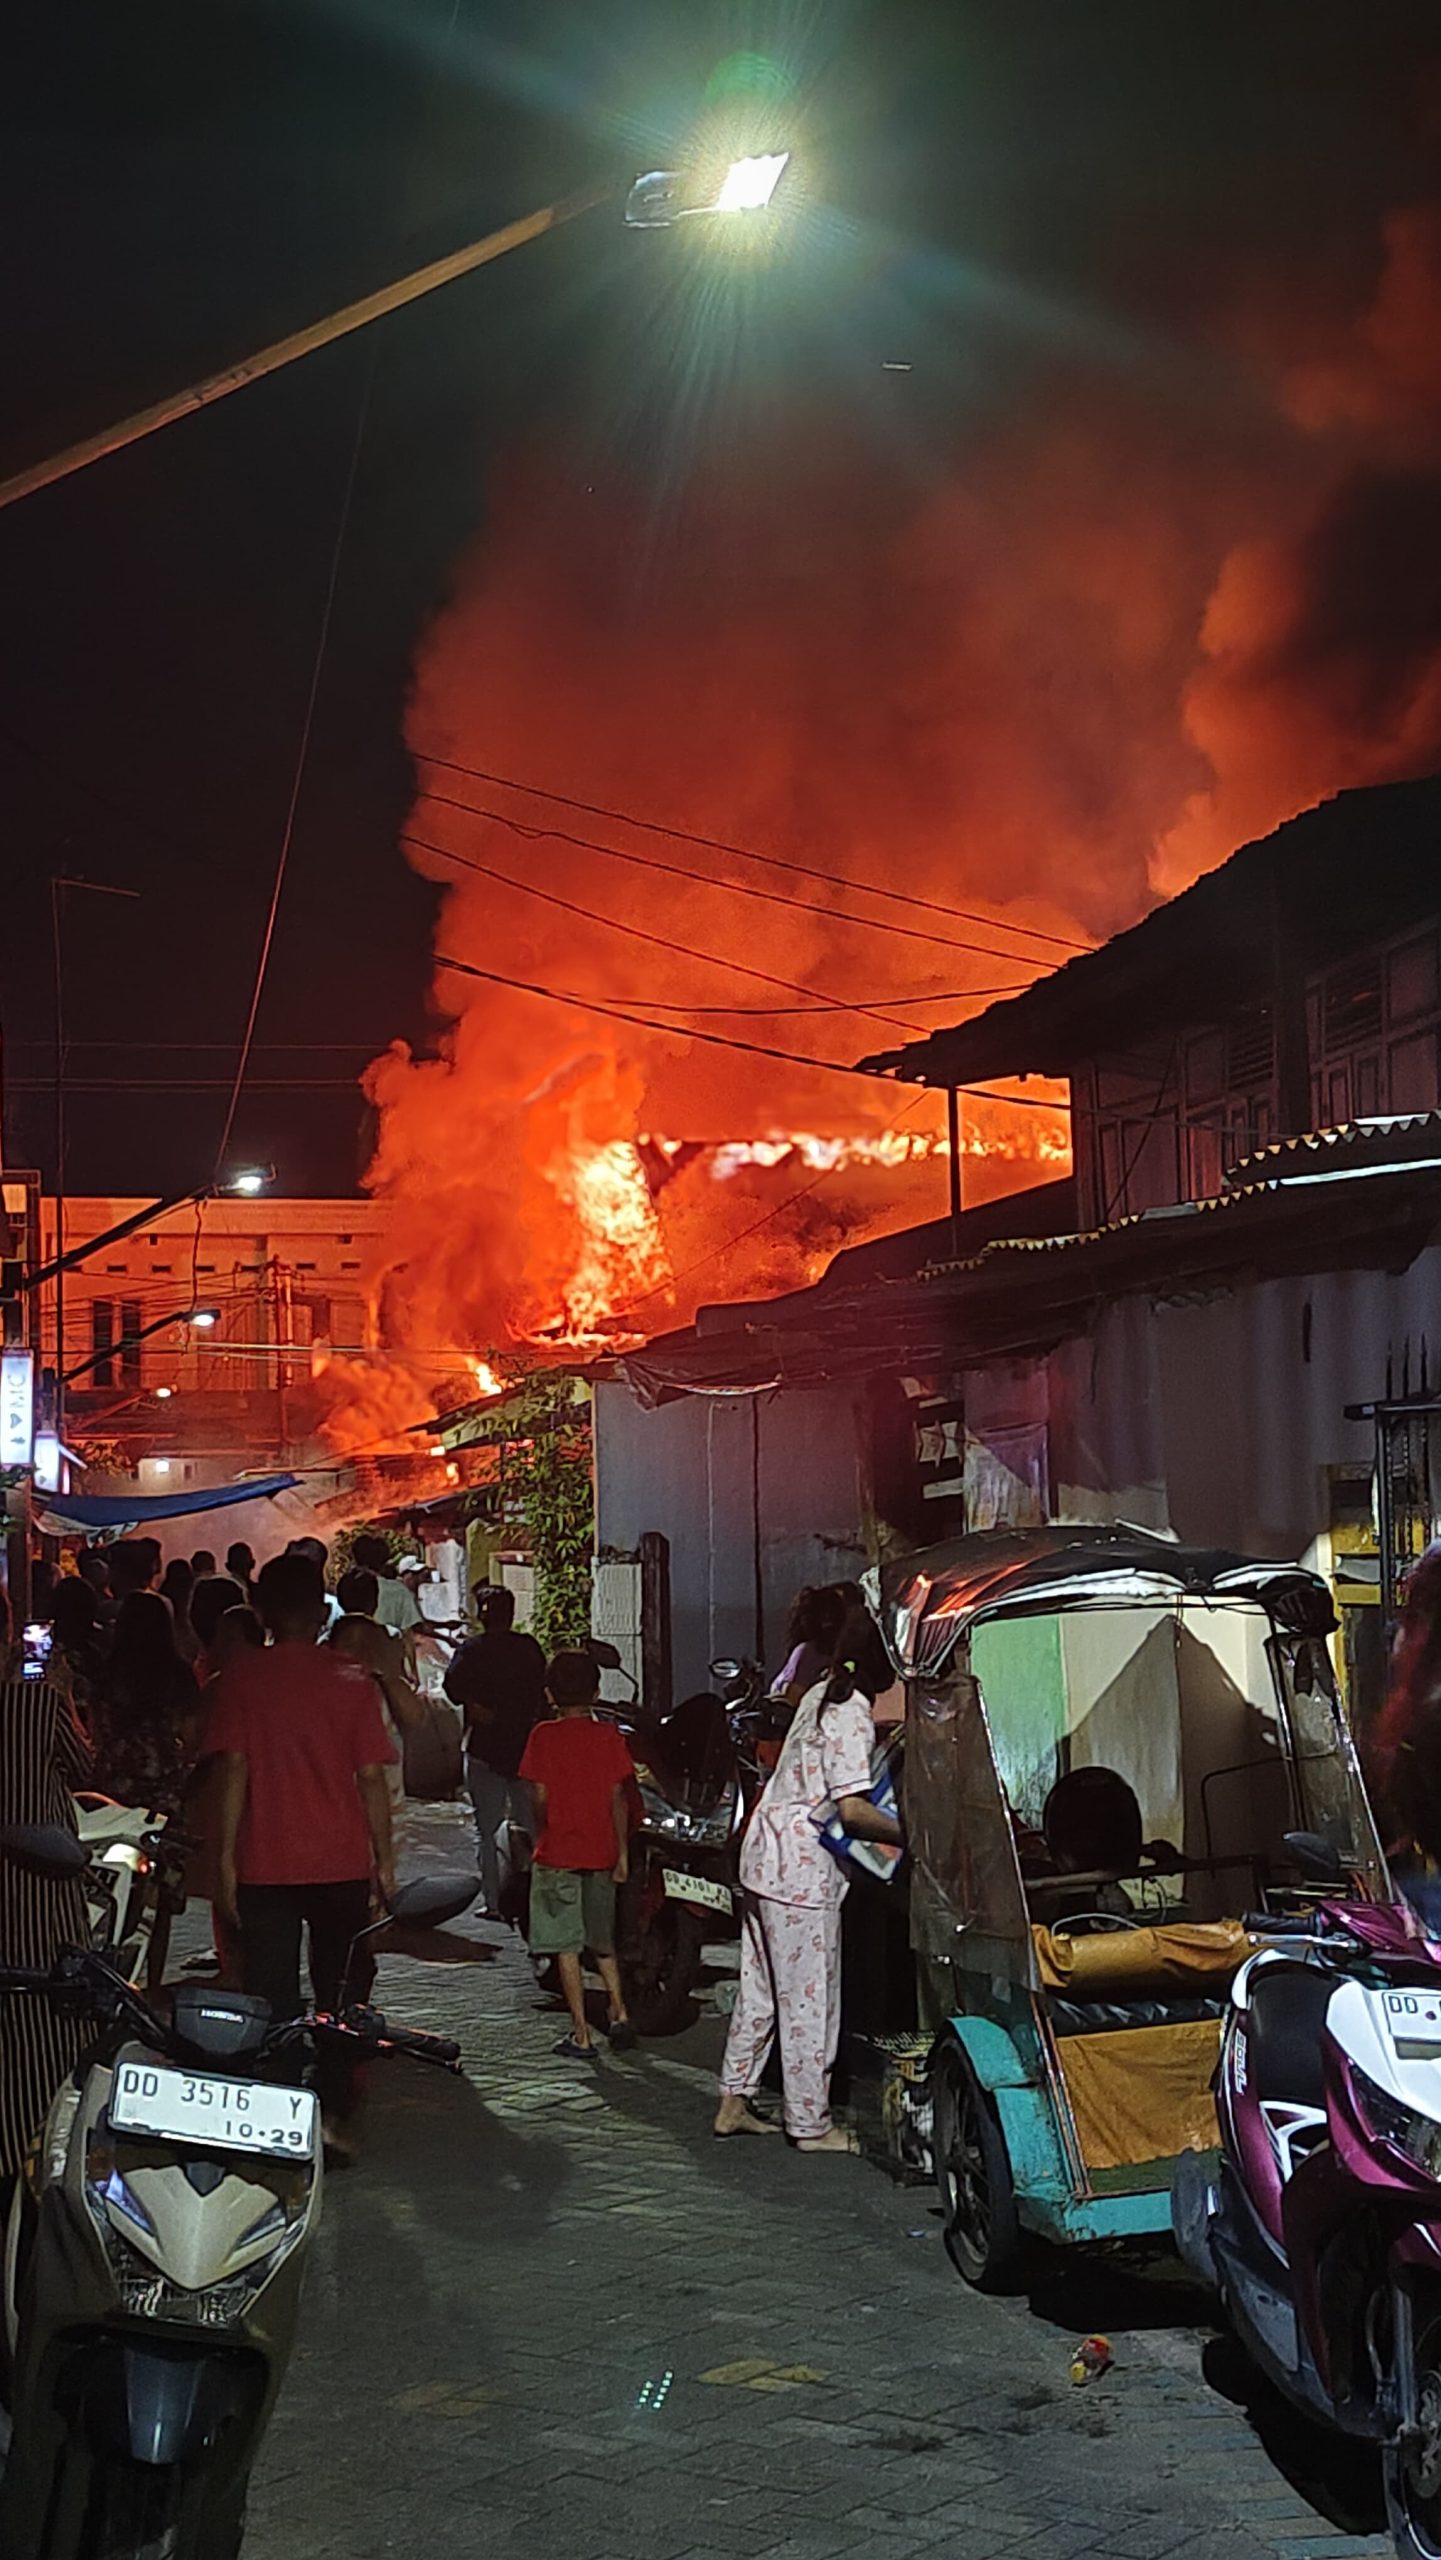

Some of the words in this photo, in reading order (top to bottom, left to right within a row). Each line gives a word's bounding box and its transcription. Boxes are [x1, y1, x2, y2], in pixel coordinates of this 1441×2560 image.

[1388, 1996, 1419, 2014] DD
[123, 2070, 158, 2097] DD
[180, 2079, 251, 2111] 3516
[289, 2096, 303, 2119] Y
